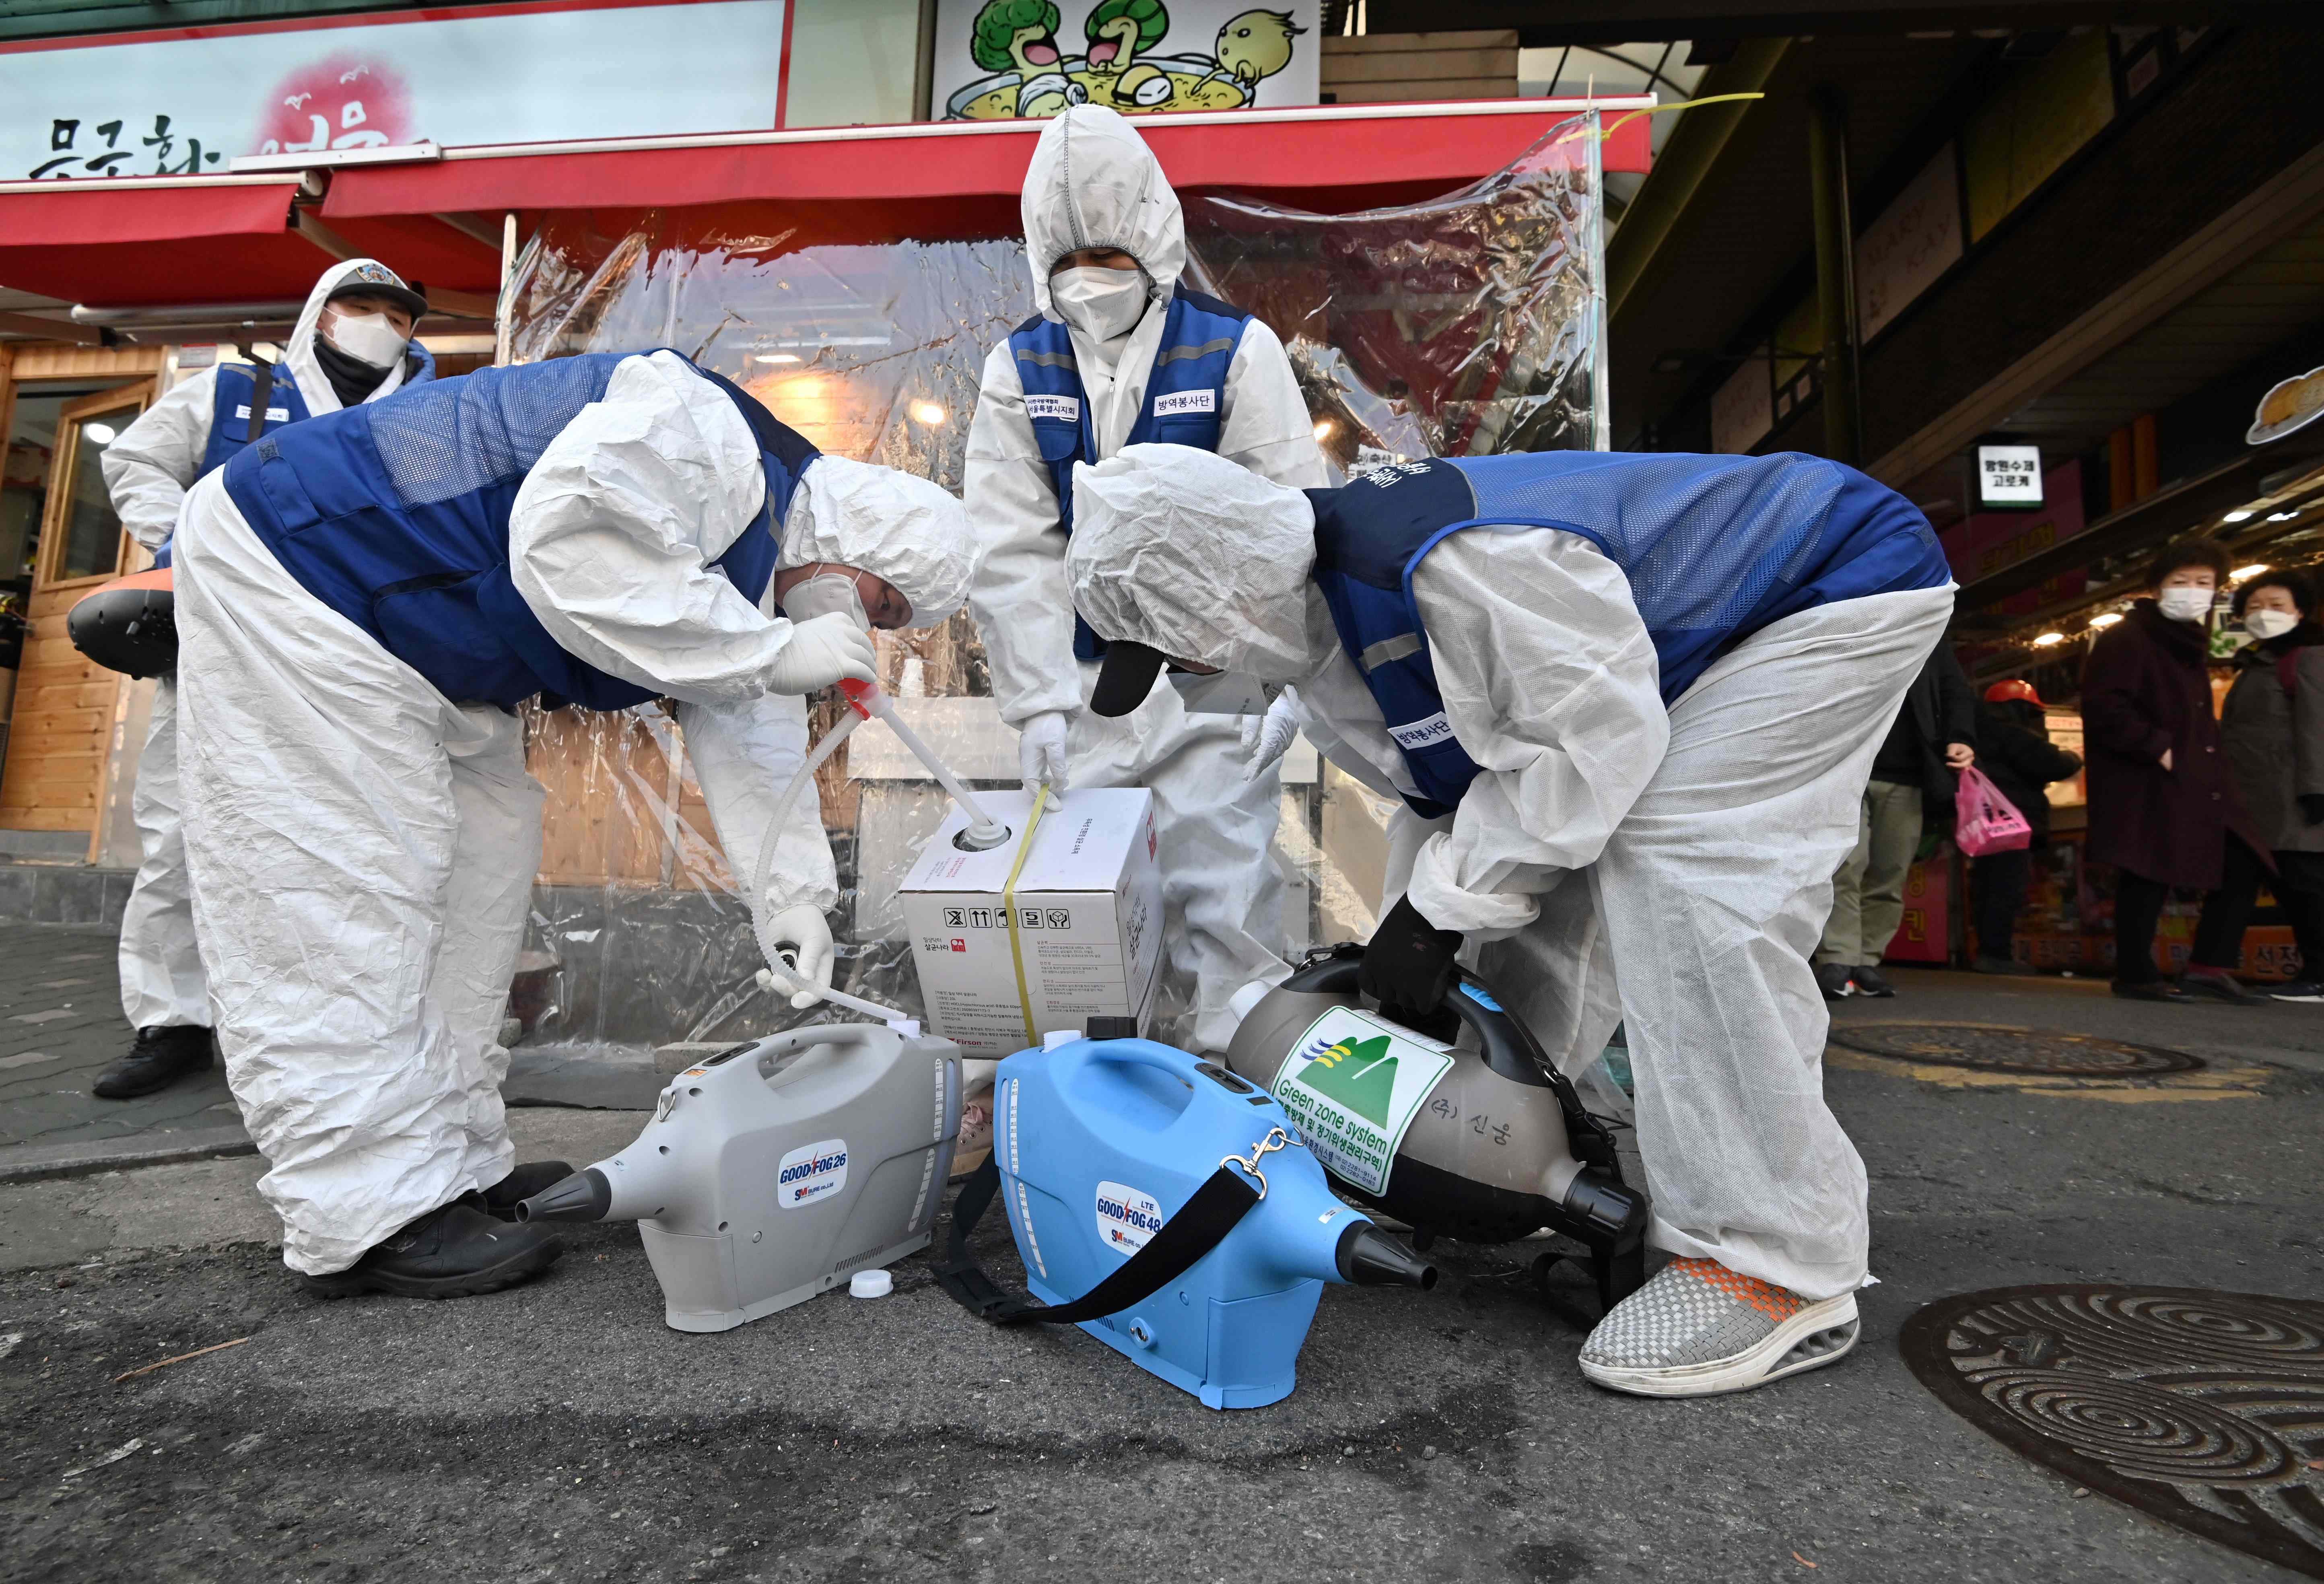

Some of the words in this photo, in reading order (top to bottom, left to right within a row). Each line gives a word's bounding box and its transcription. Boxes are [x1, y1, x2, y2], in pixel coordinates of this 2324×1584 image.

[1158, 395, 1210, 411] 방역봉사단
[1030, 405, 1075, 416] 서울특별시지회
[1993, 475, 2029, 487] 고로케
[1396, 720, 1451, 744] 방역봉사단
[1279, 1079, 1314, 1112] Green
[1314, 1103, 1344, 1129] zone
[1346, 1121, 1387, 1155] system
[1302, 1134, 1334, 1162] 웃환경시스템
[1306, 1118, 1315, 1132] 및
[1317, 1123, 1382, 1172] 정기위생관리구역)
[808, 1186, 820, 1194] BURE
[1141, 1201, 1154, 1211] LTE
[1123, 1237, 1135, 1246] BURE
